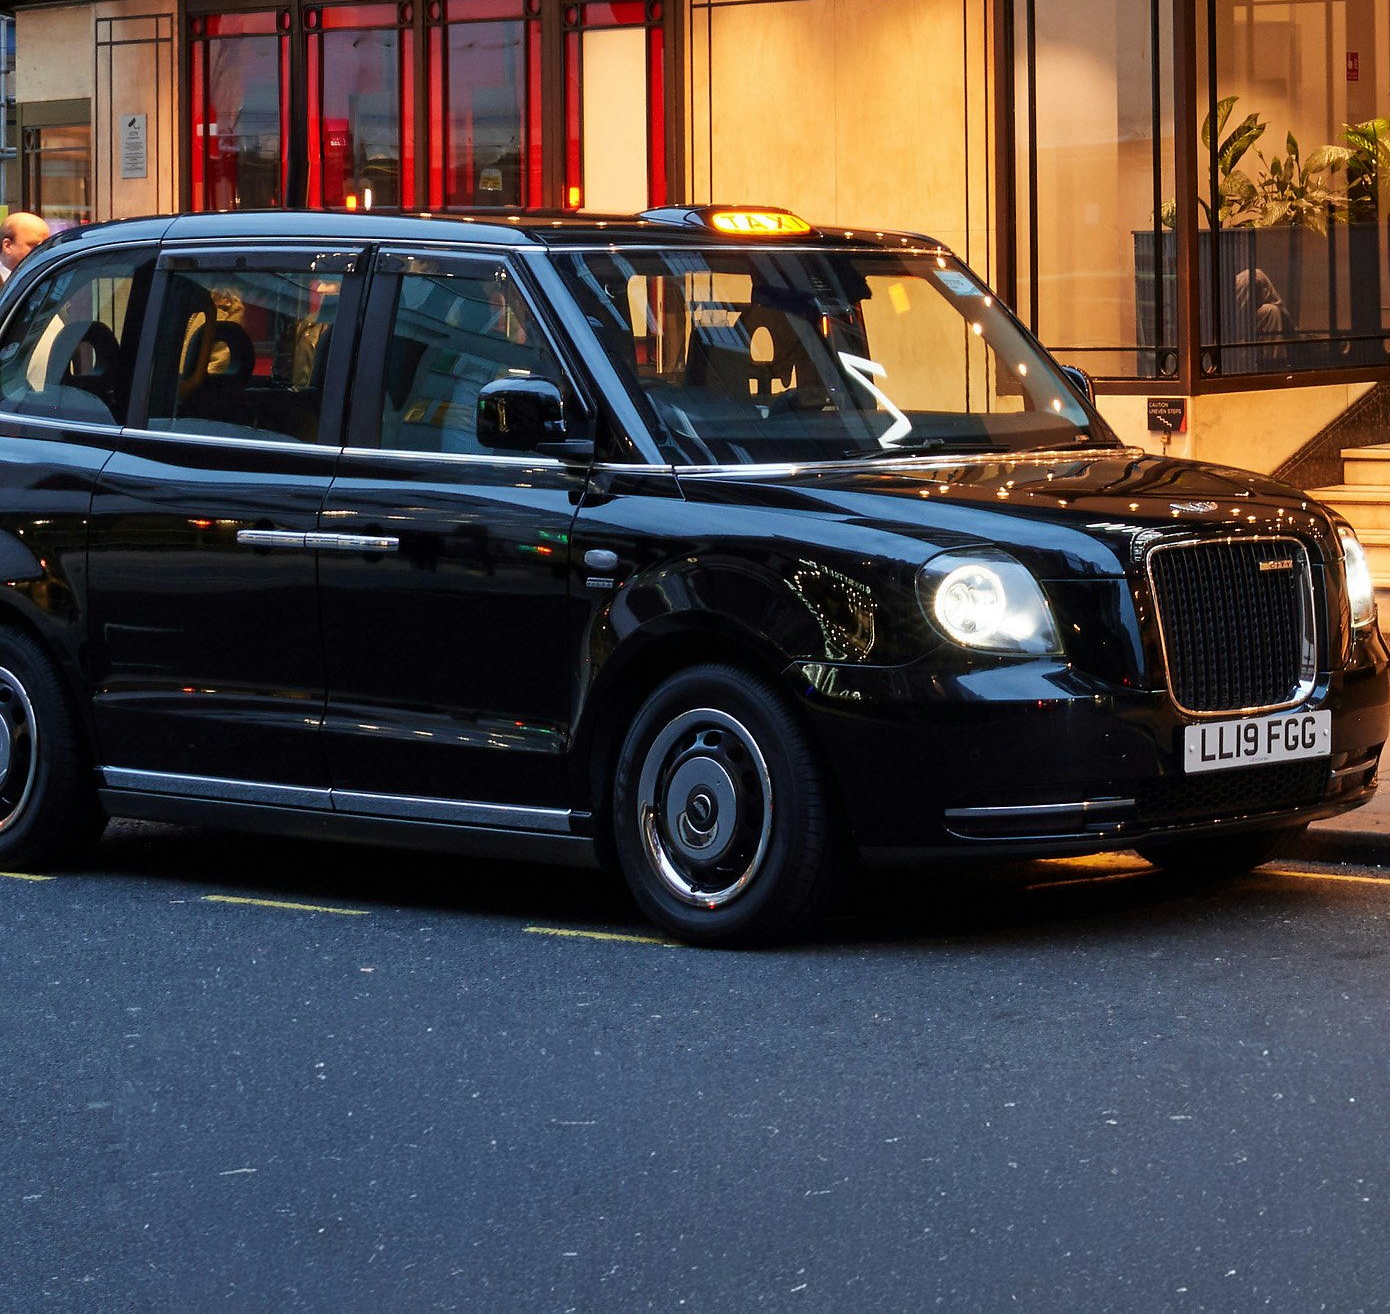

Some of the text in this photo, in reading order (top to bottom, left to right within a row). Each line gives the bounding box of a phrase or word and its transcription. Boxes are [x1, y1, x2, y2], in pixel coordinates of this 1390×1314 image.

[720, 215, 804, 230] TAXI
[1201, 716, 1316, 762] LL19 FGG
